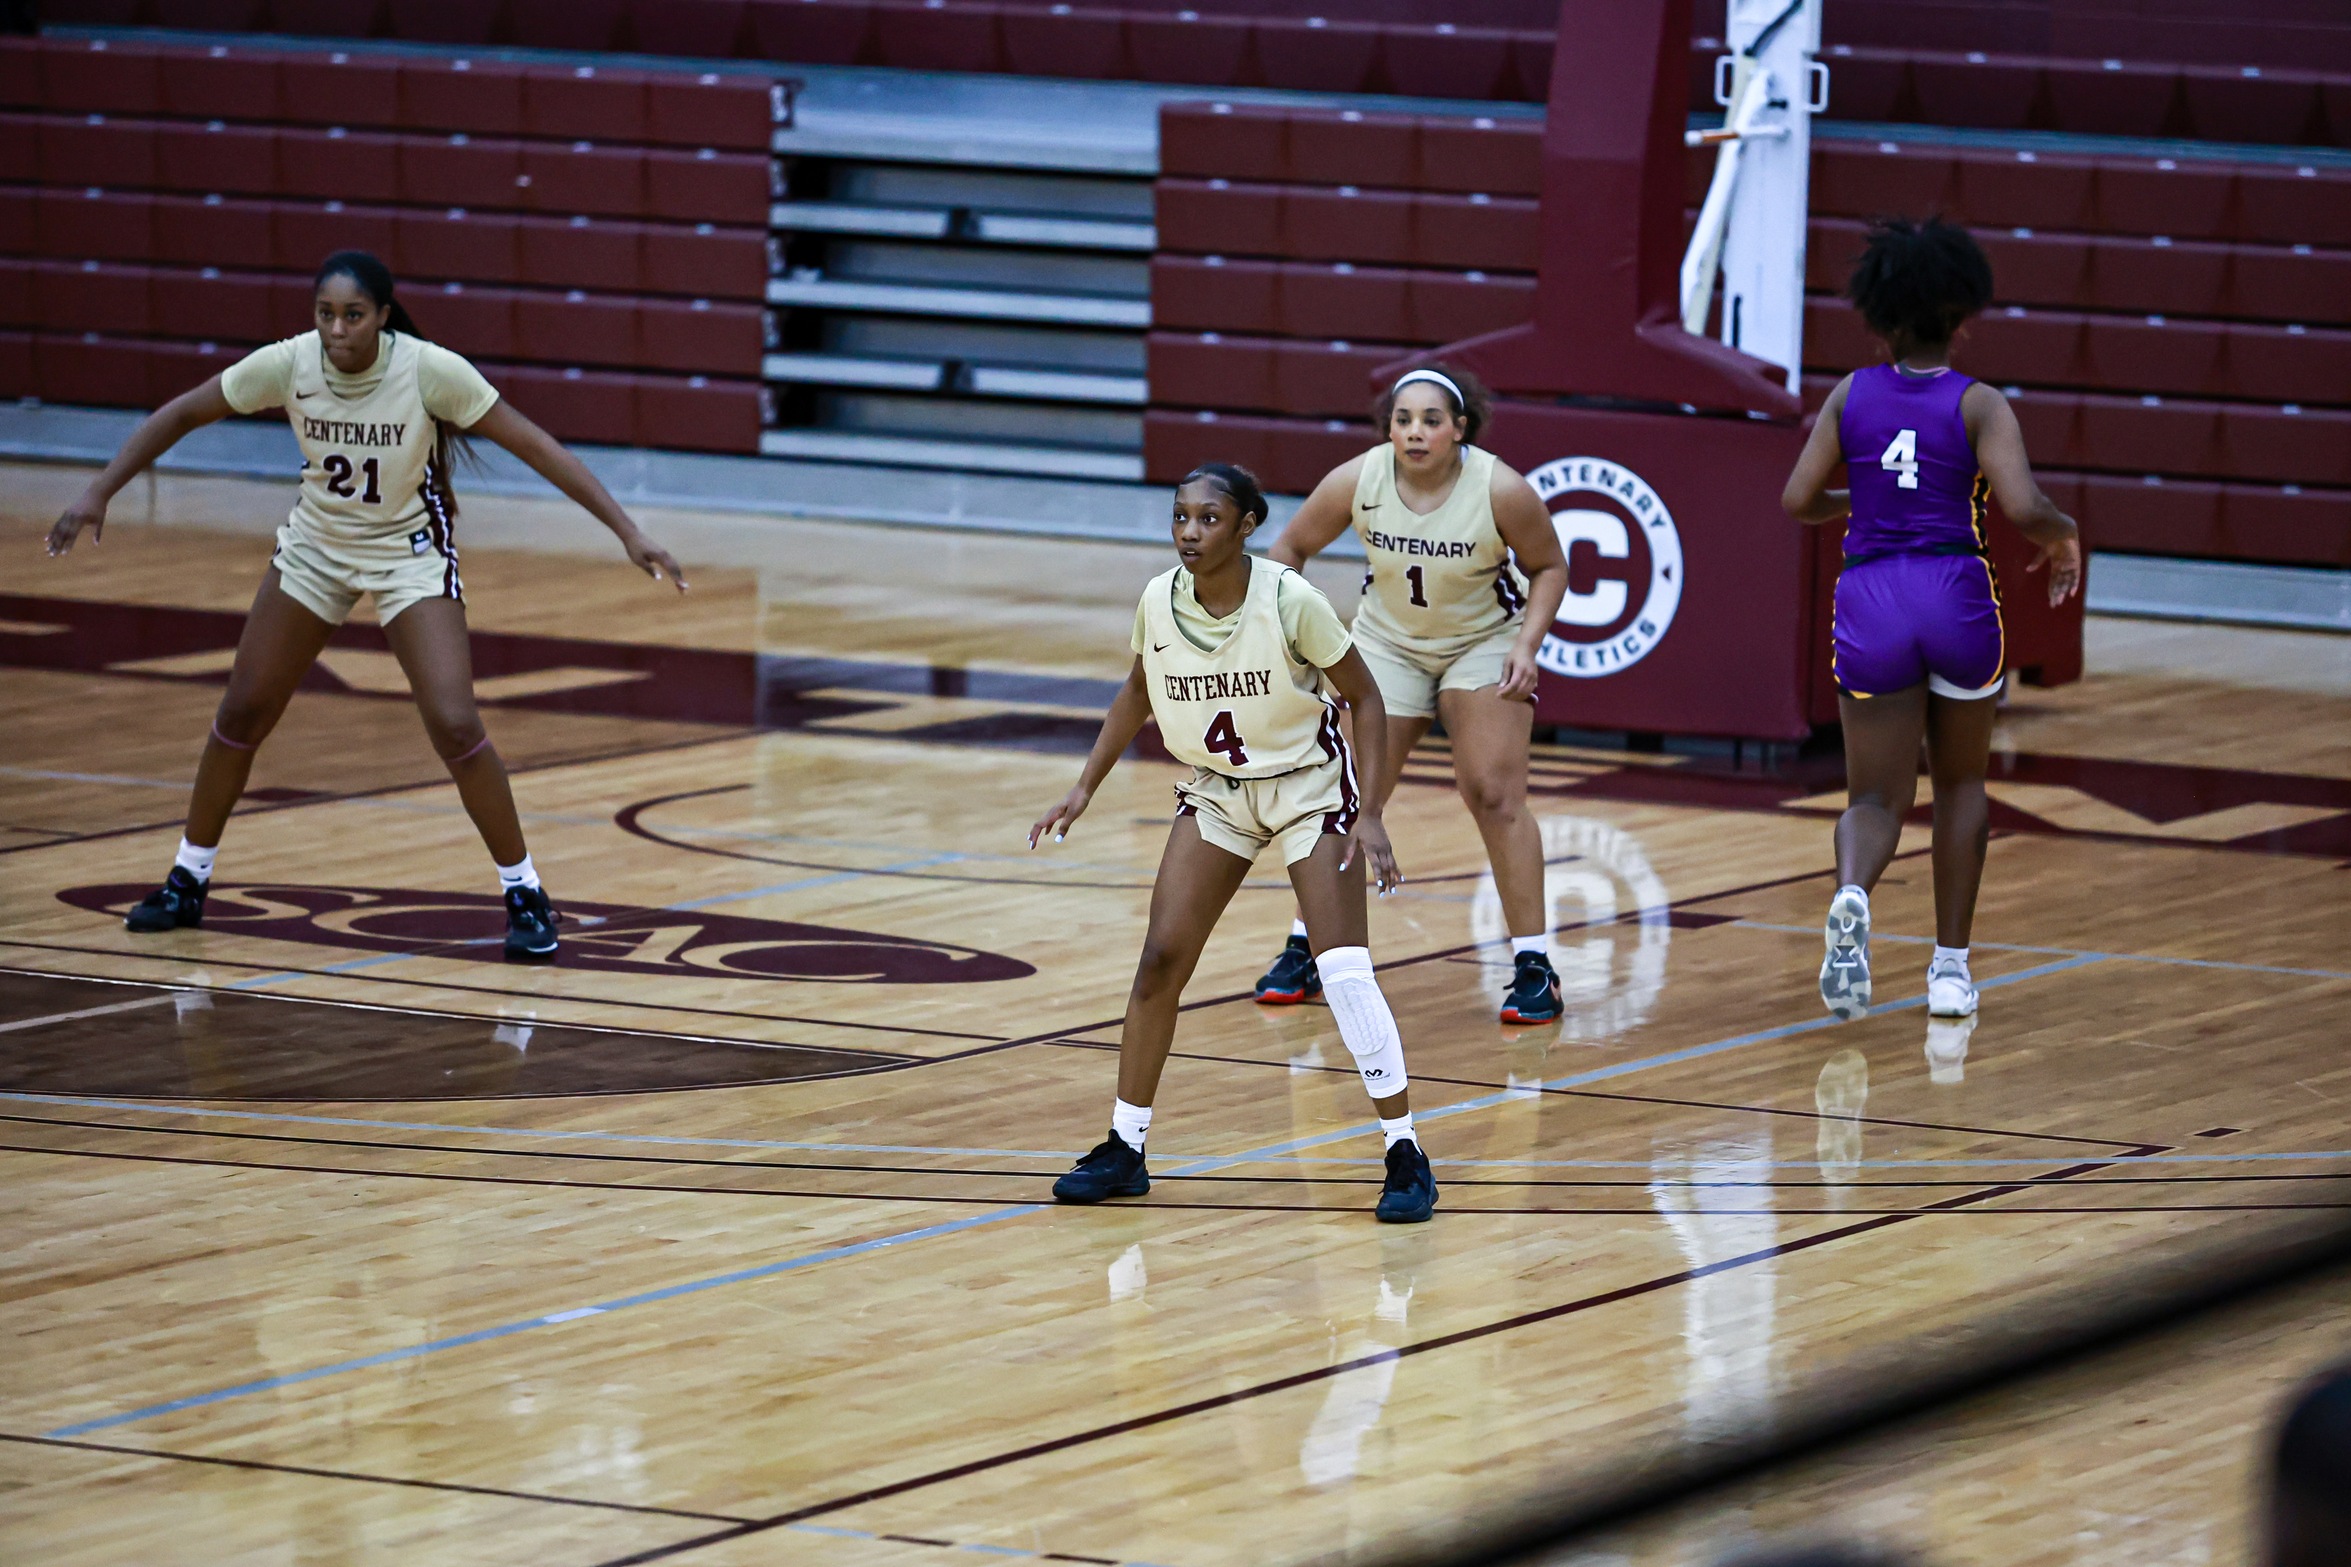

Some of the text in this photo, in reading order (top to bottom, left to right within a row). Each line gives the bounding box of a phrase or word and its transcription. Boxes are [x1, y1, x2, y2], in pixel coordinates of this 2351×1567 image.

[304, 417, 406, 446] CENTENARY
[323, 454, 382, 504] 21
[1880, 428, 1919, 490] 4
[1538, 464, 1666, 528] NTENARY
[1405, 564, 1430, 609] 1
[1550, 508, 1630, 627] C
[1164, 669, 1272, 702] CENTENARY
[1203, 709, 1250, 767] 4
